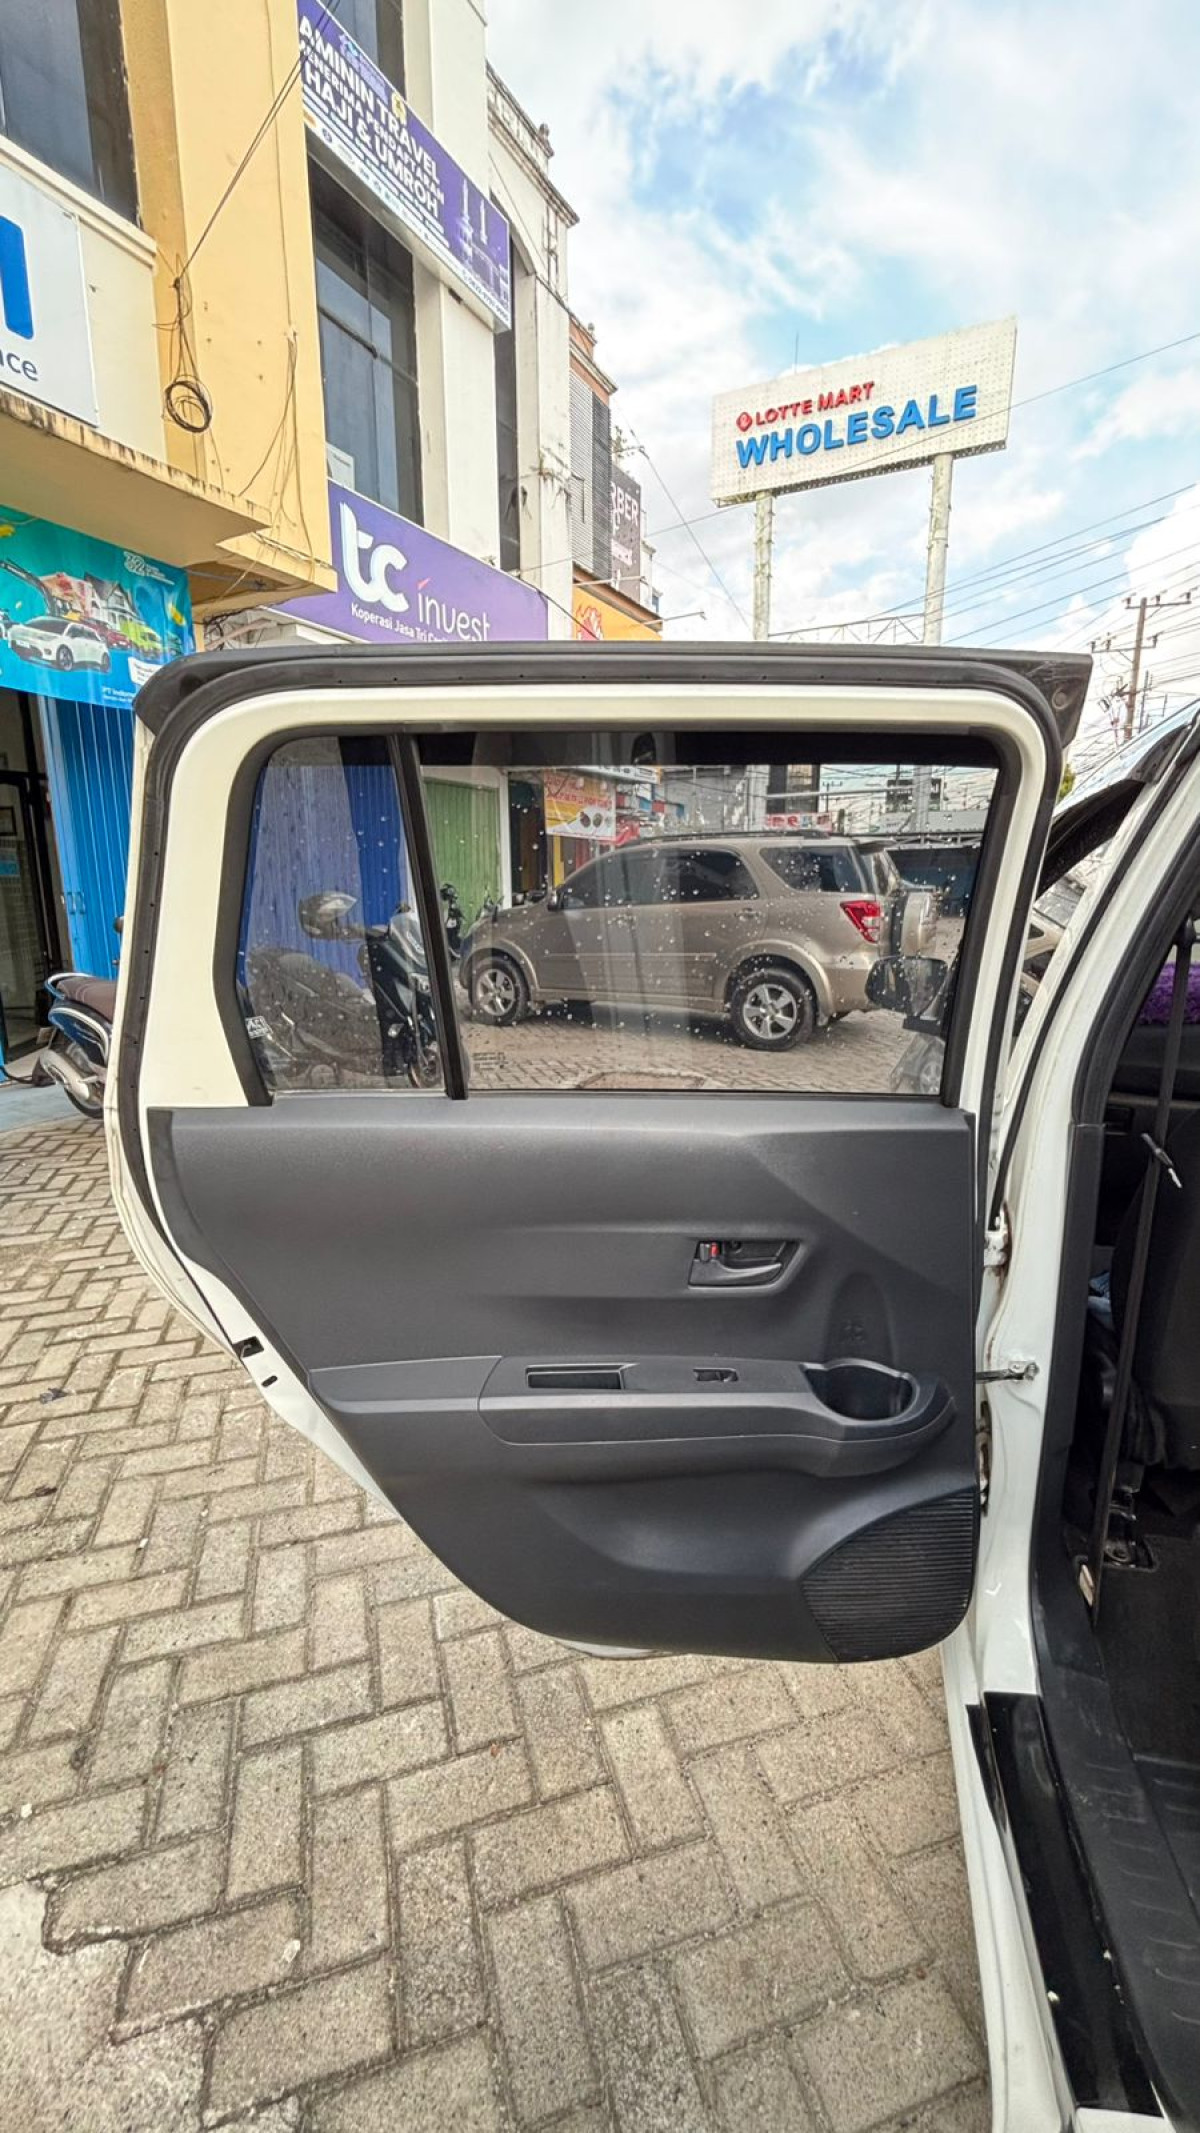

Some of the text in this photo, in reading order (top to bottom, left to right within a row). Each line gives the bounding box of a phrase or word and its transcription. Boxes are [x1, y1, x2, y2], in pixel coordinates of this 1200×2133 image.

[300, 15, 374, 113] AMININ
[376, 97, 440, 184] TRAVEL
[304, 60, 353, 130] HAJI
[356, 117, 373, 150] &
[374, 135, 438, 219] UMROH
[366, 110, 445, 206] PENDAFTARAN
[736, 385, 977, 469] WHOLESALE
[756, 381, 875, 426] LOTTE MART
[351, 602, 393, 631] Koperasi
[394, 619, 414, 638] Jasa
[417, 577, 490, 641] invest
